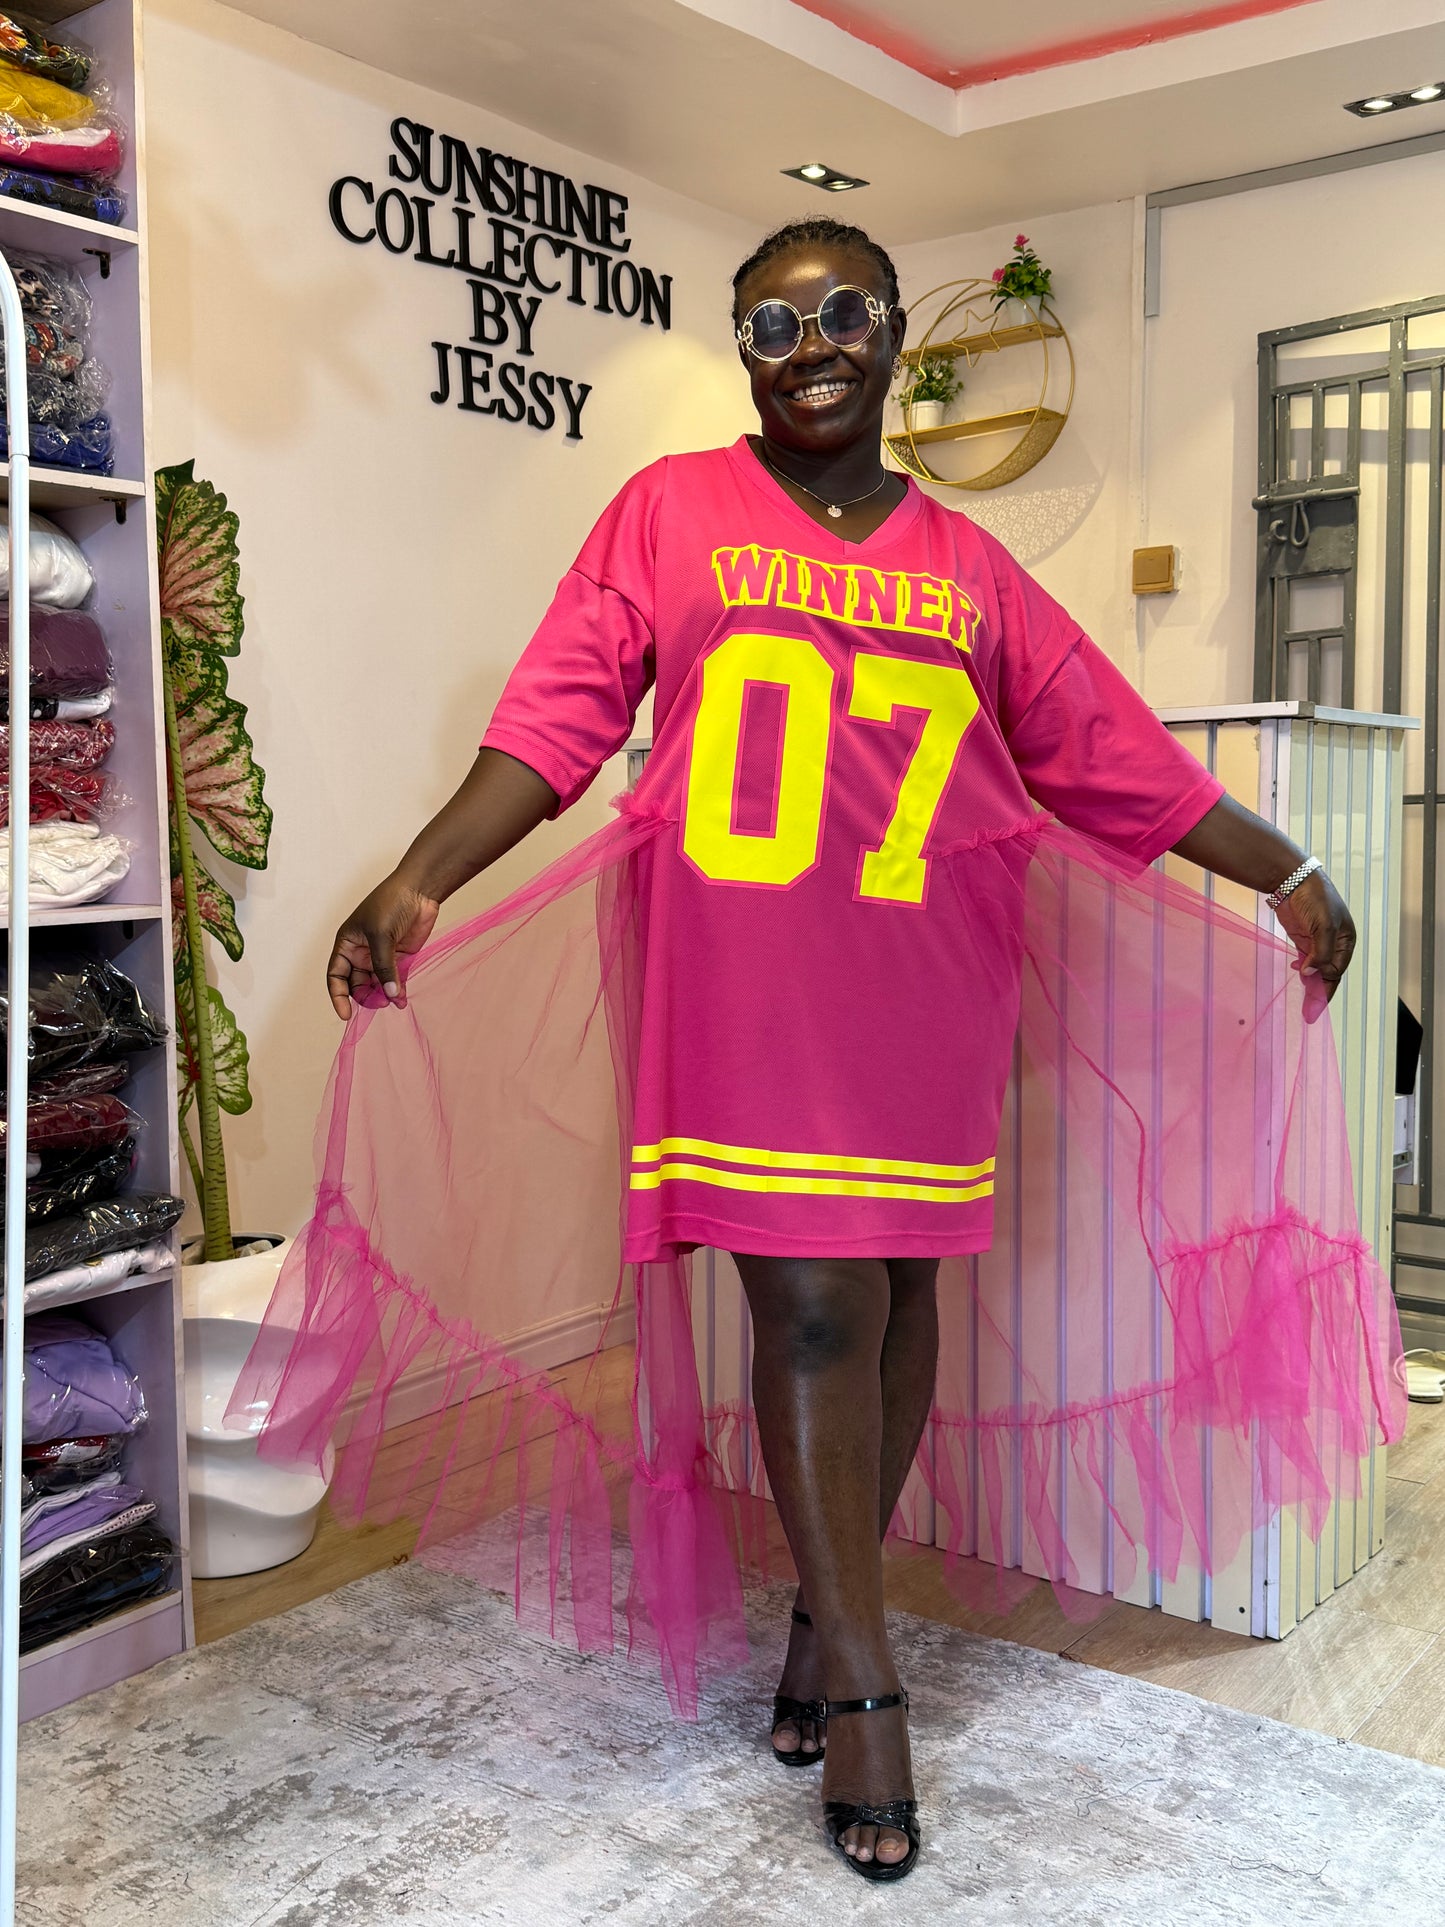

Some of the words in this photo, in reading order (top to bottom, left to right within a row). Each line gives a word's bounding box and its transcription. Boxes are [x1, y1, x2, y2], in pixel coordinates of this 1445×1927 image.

[389, 116, 631, 252] SUNSHINE
[328, 175, 673, 331] COLLECTION
[466, 278, 542, 356] BY
[430, 341, 593, 440] JESSY
[711, 543, 982, 654] WINNER
[678, 628, 981, 909] 07
